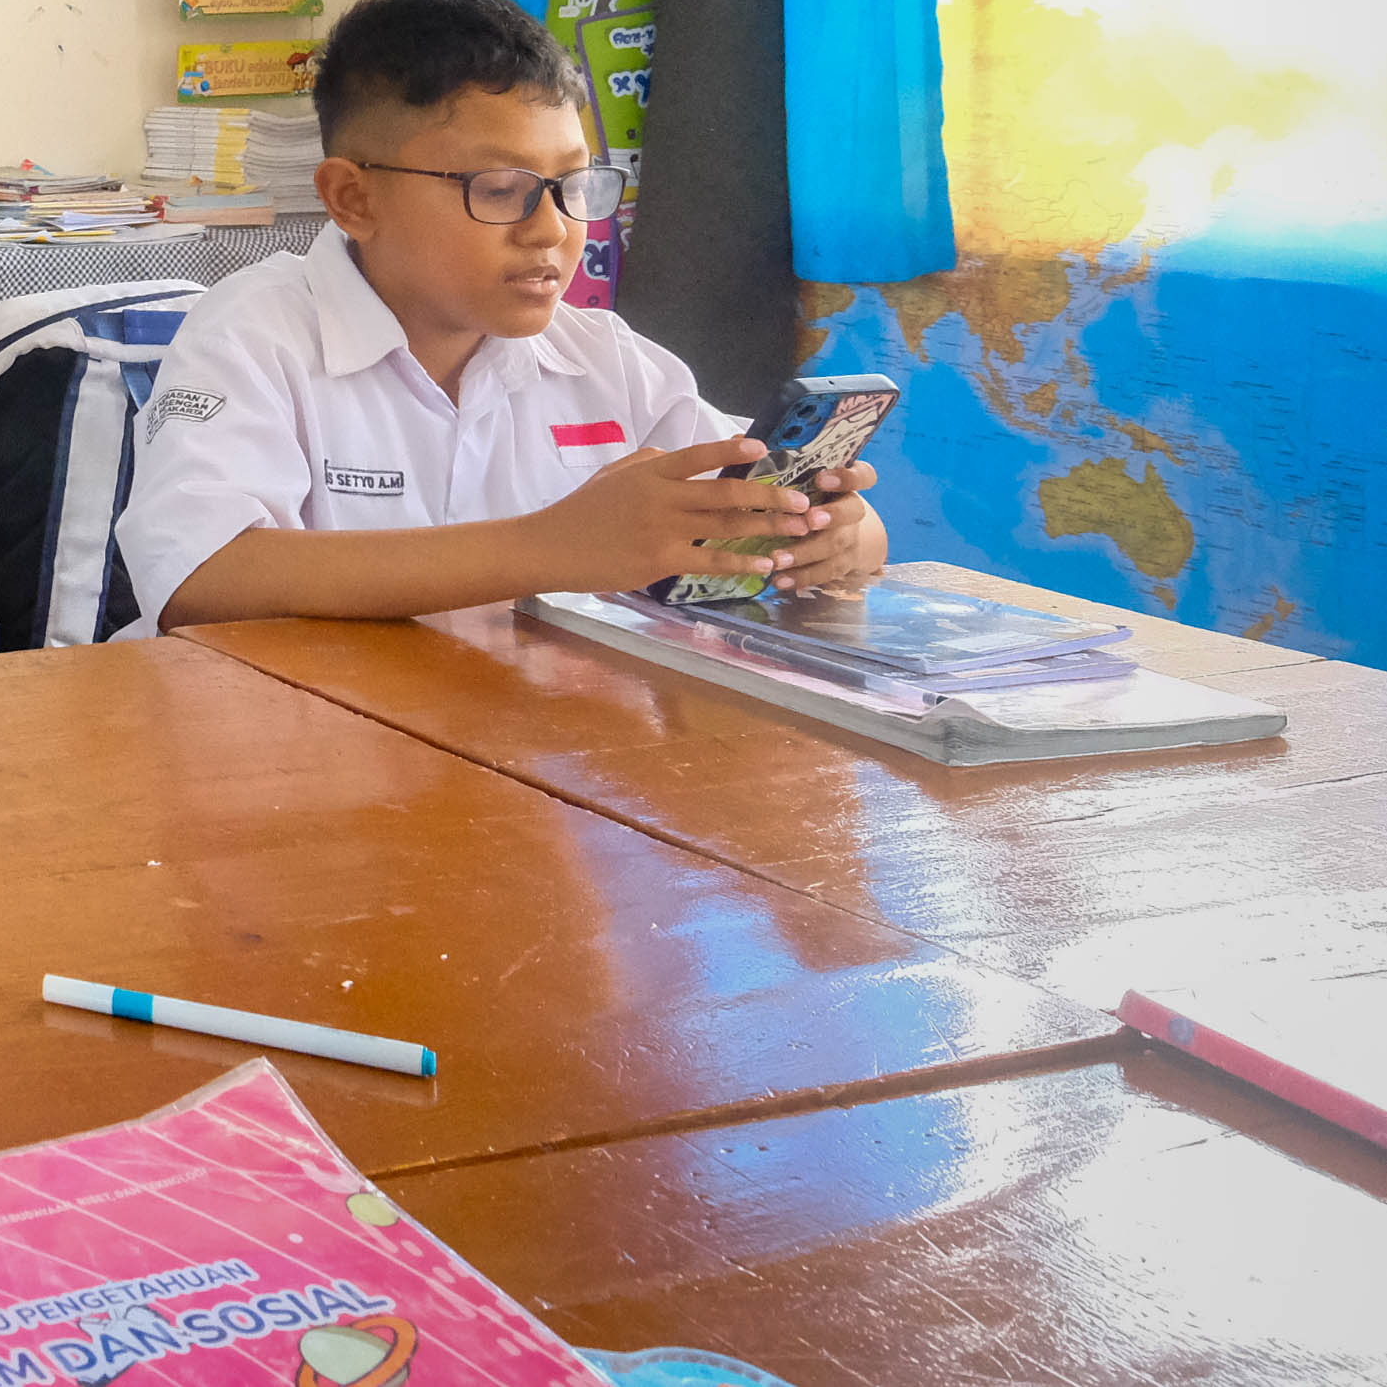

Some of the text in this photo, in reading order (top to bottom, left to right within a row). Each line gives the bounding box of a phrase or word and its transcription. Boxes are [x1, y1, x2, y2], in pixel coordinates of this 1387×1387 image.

[206, 60, 244, 74] BUKU
[255, 74, 293, 87] DUNIA
[796, 451, 822, 474] MAX
[336, 474, 375, 489] SETYO
[23, 1262, 252, 1324] PENGETAHUAN
[51, 1320, 182, 1373] DAN
[183, 1284, 389, 1345] SOSIAL
